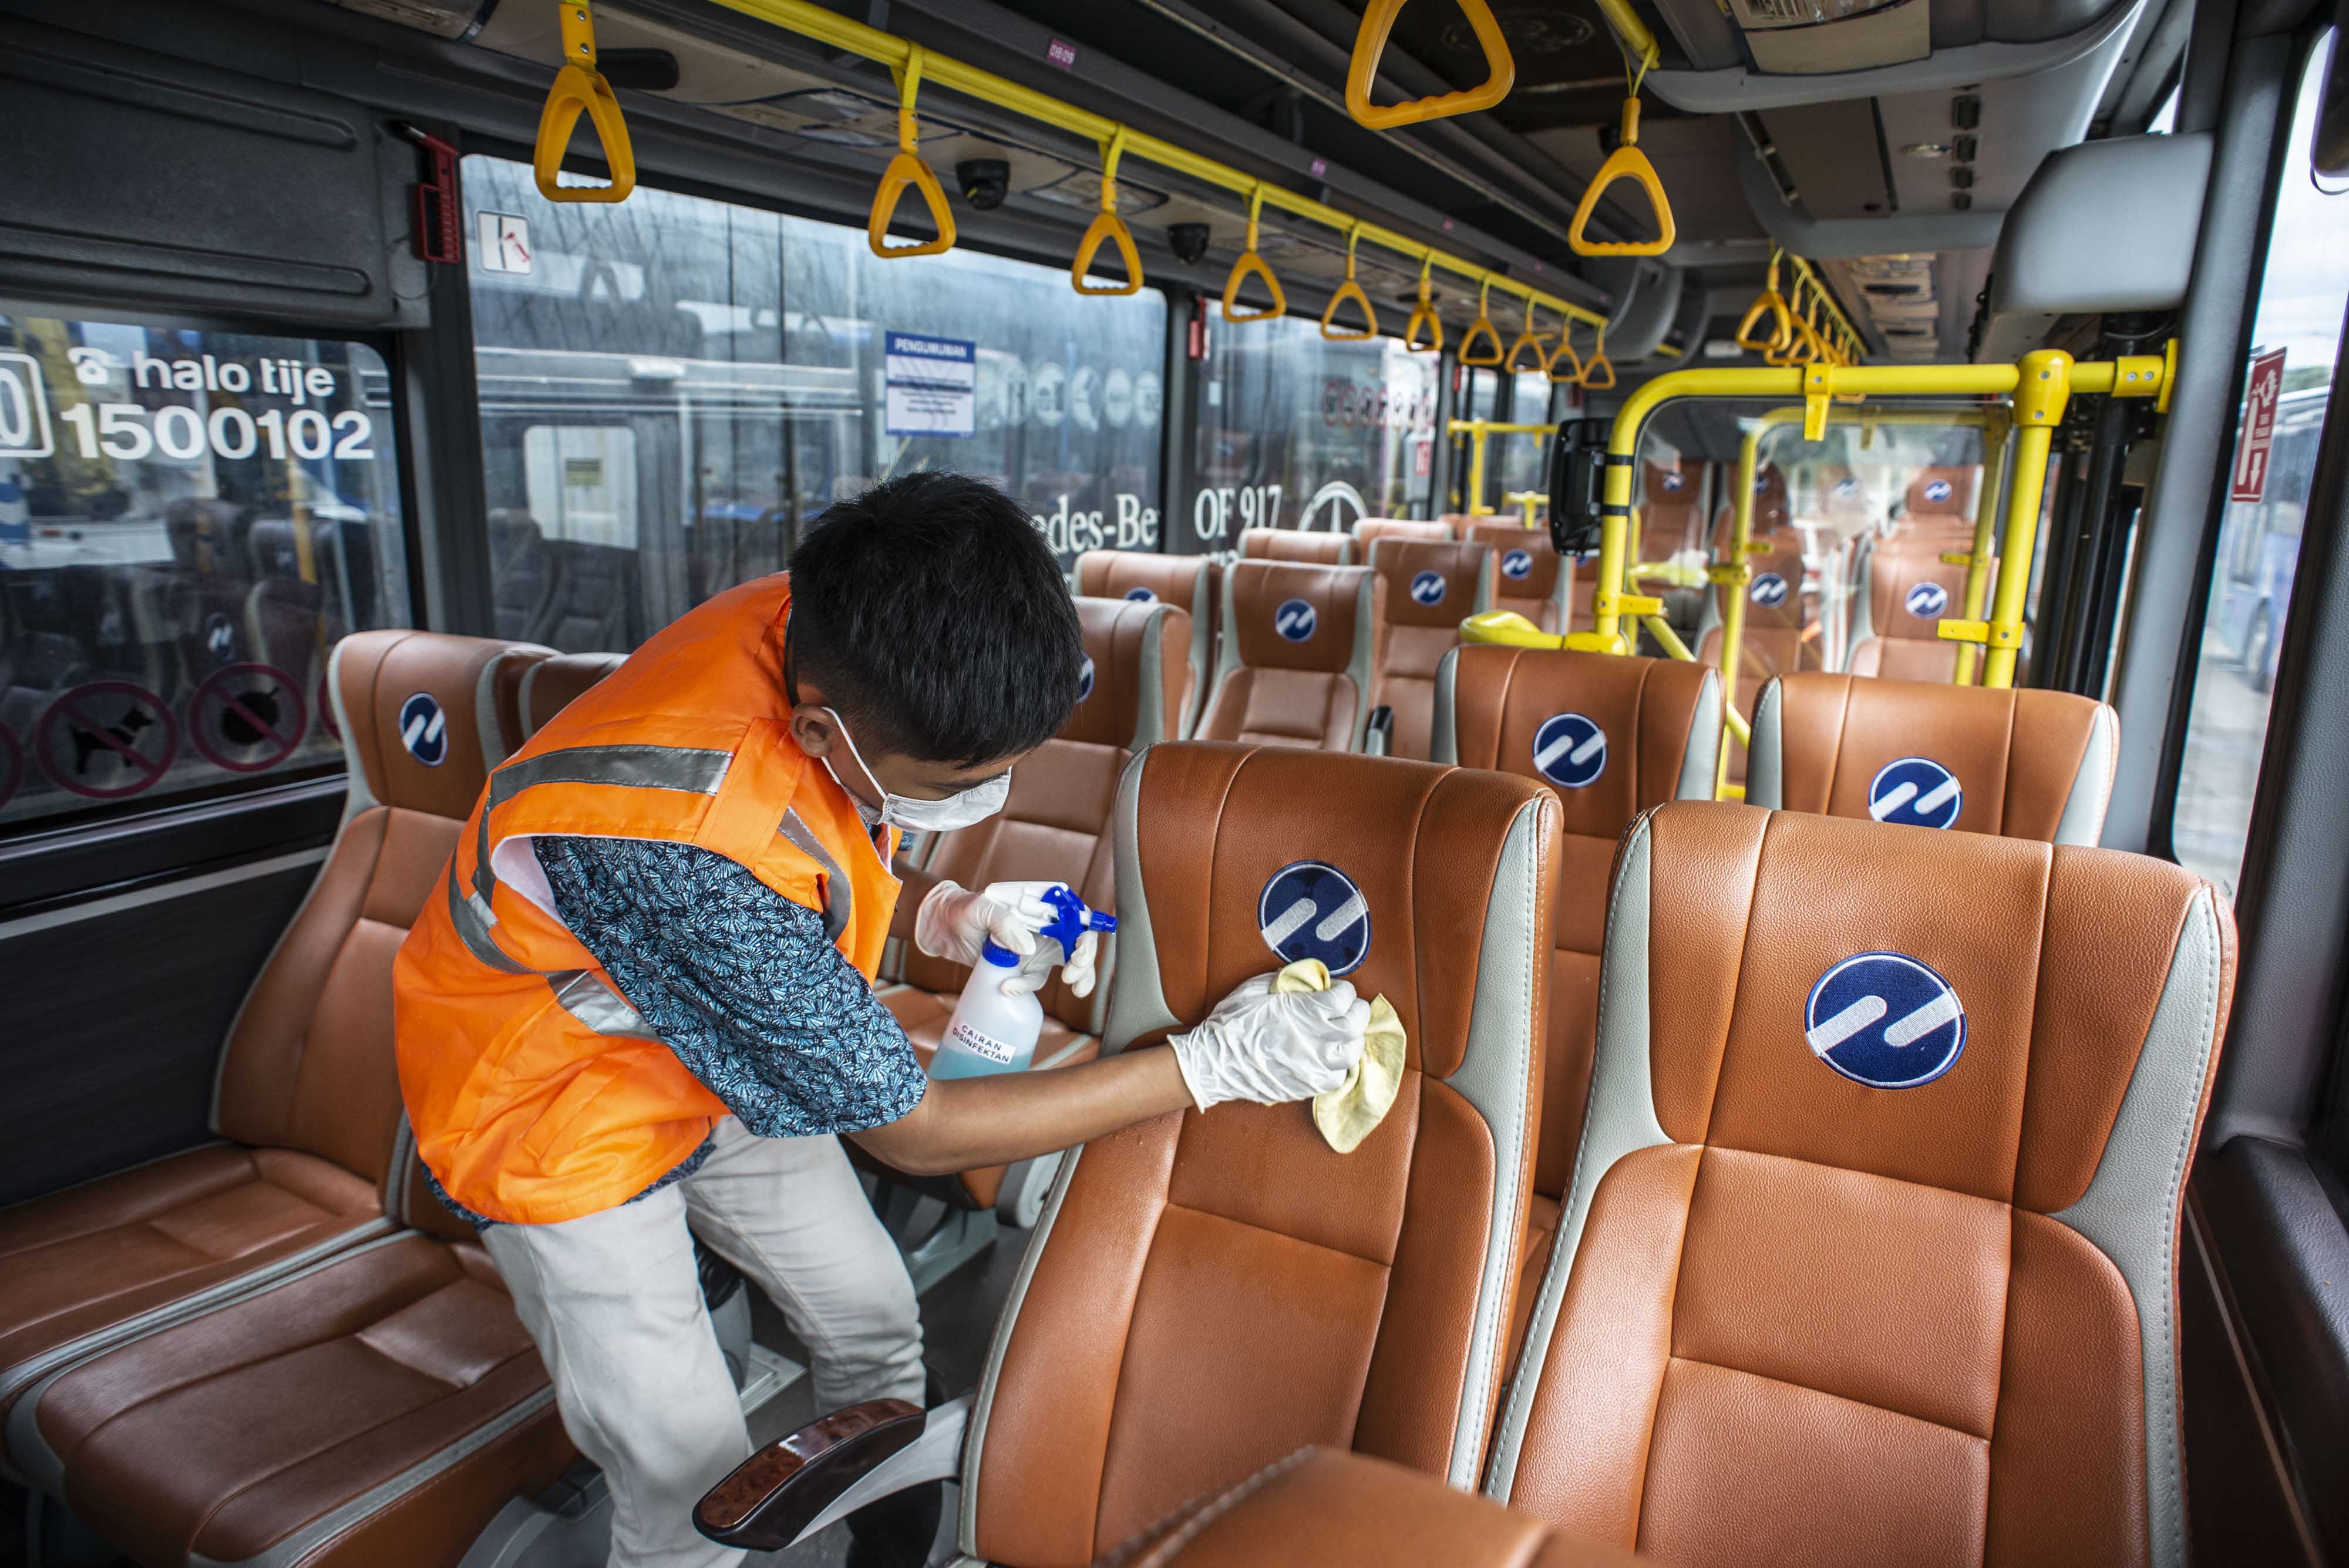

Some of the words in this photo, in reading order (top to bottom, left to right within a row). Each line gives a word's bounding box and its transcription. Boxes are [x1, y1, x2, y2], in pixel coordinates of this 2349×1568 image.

[133, 350, 251, 393] halo
[260, 358, 335, 405] tije
[60, 402, 375, 460] 1500102
[1194, 488, 1236, 540] OF
[1239, 484, 1283, 529] 917
[953, 1027, 1009, 1062] DISINFEKTAN
[962, 1025, 1001, 1051] CAIRAN
